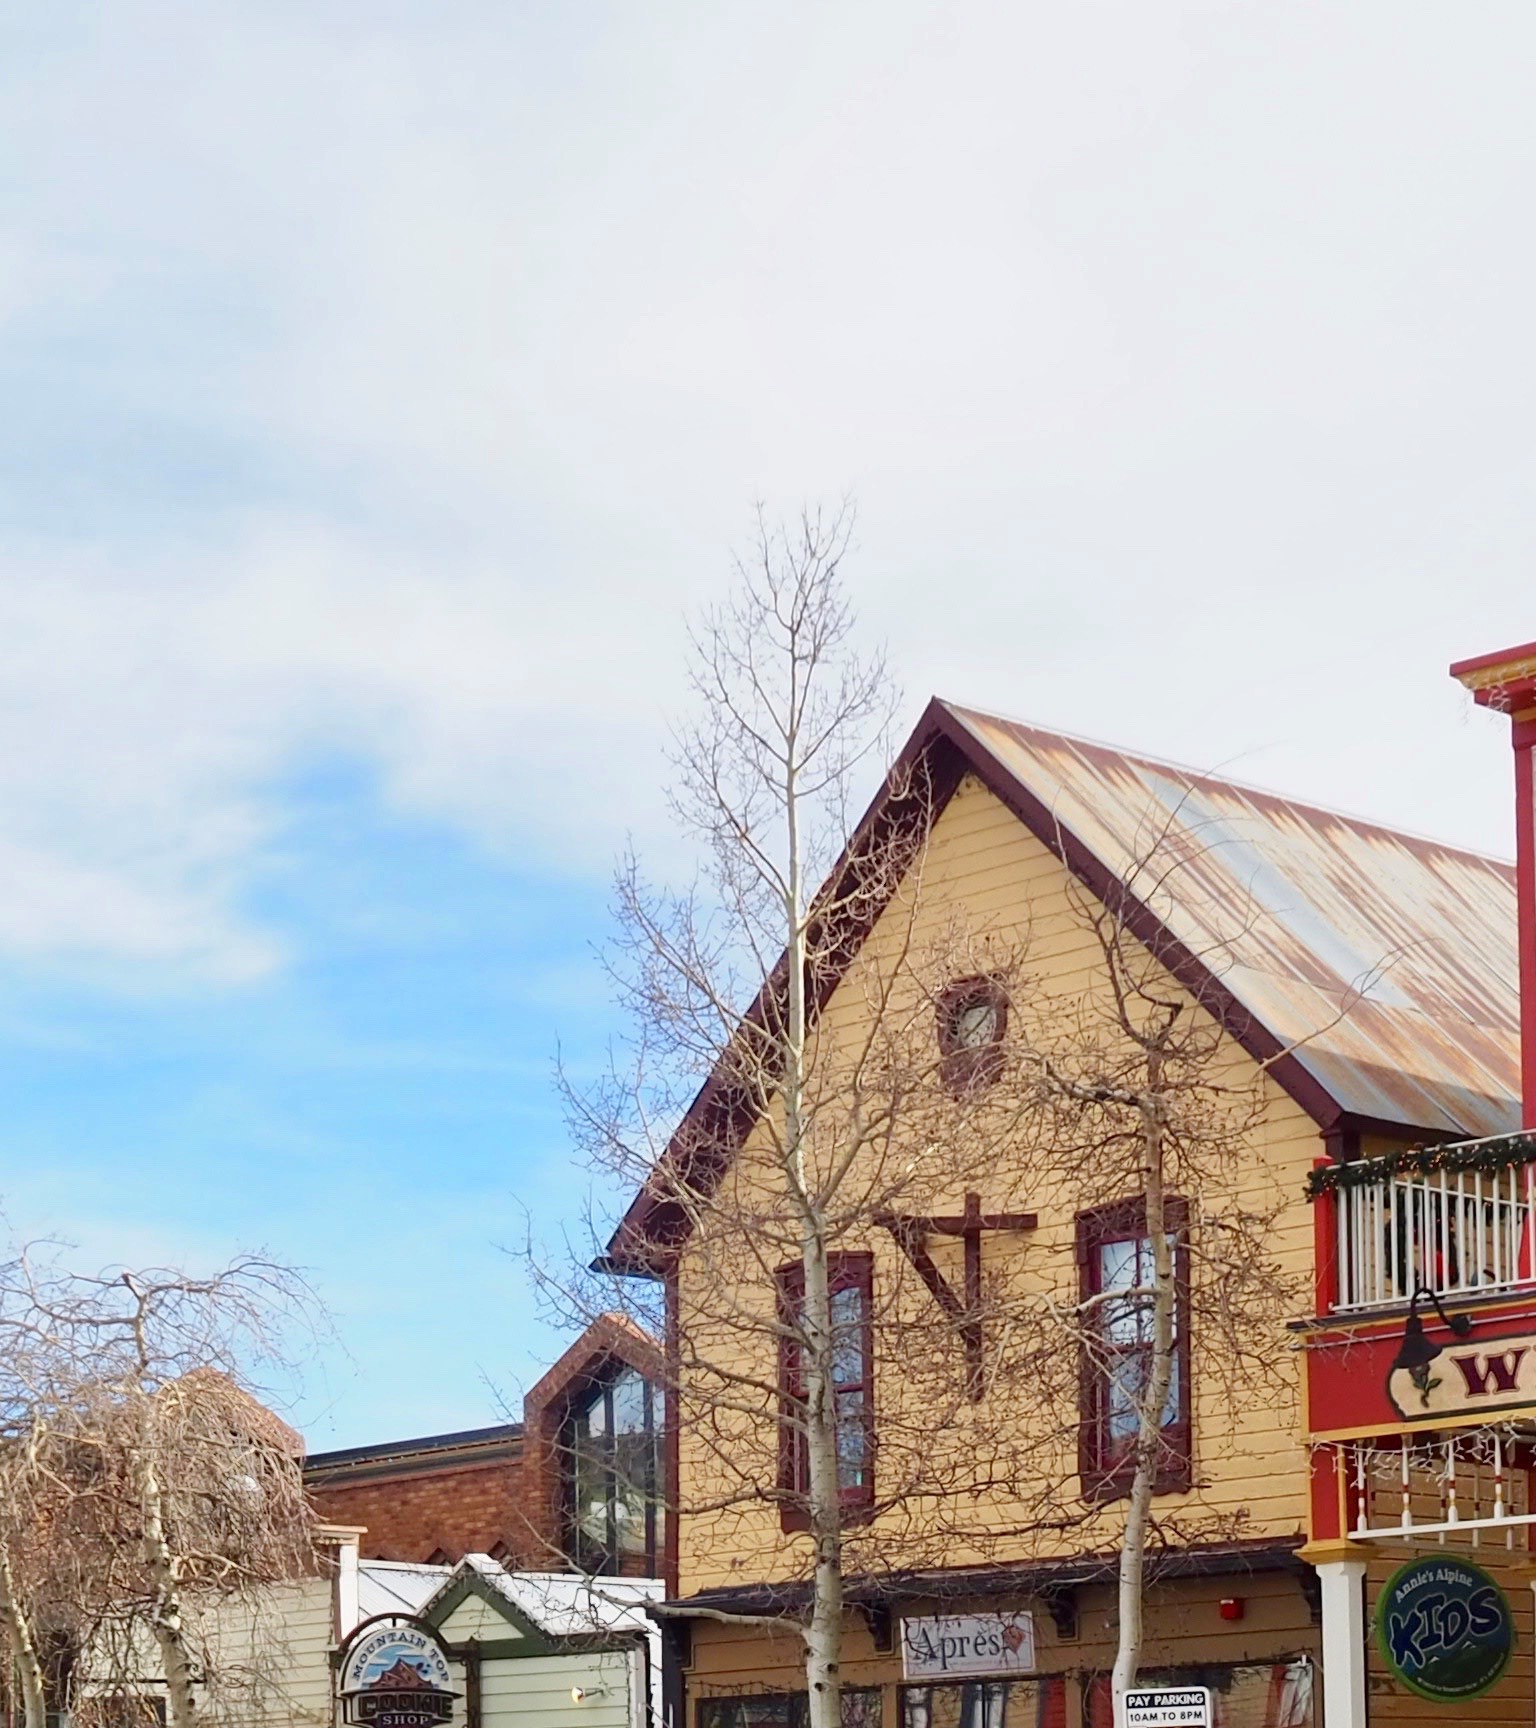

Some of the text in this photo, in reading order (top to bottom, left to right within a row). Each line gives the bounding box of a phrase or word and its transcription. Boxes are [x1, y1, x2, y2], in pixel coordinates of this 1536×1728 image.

[1395, 1568, 1473, 1603] Annie's Alpine
[1390, 1586, 1503, 1669] KIDS
[352, 1632, 450, 1682] MOUNTAIN TOP
[358, 1692, 454, 1719] COOKIE
[1128, 1694, 1204, 1706] PAY PARKING
[382, 1714, 429, 1726] SHOP
[1130, 1711, 1202, 1722] 10AM TO 8PM
